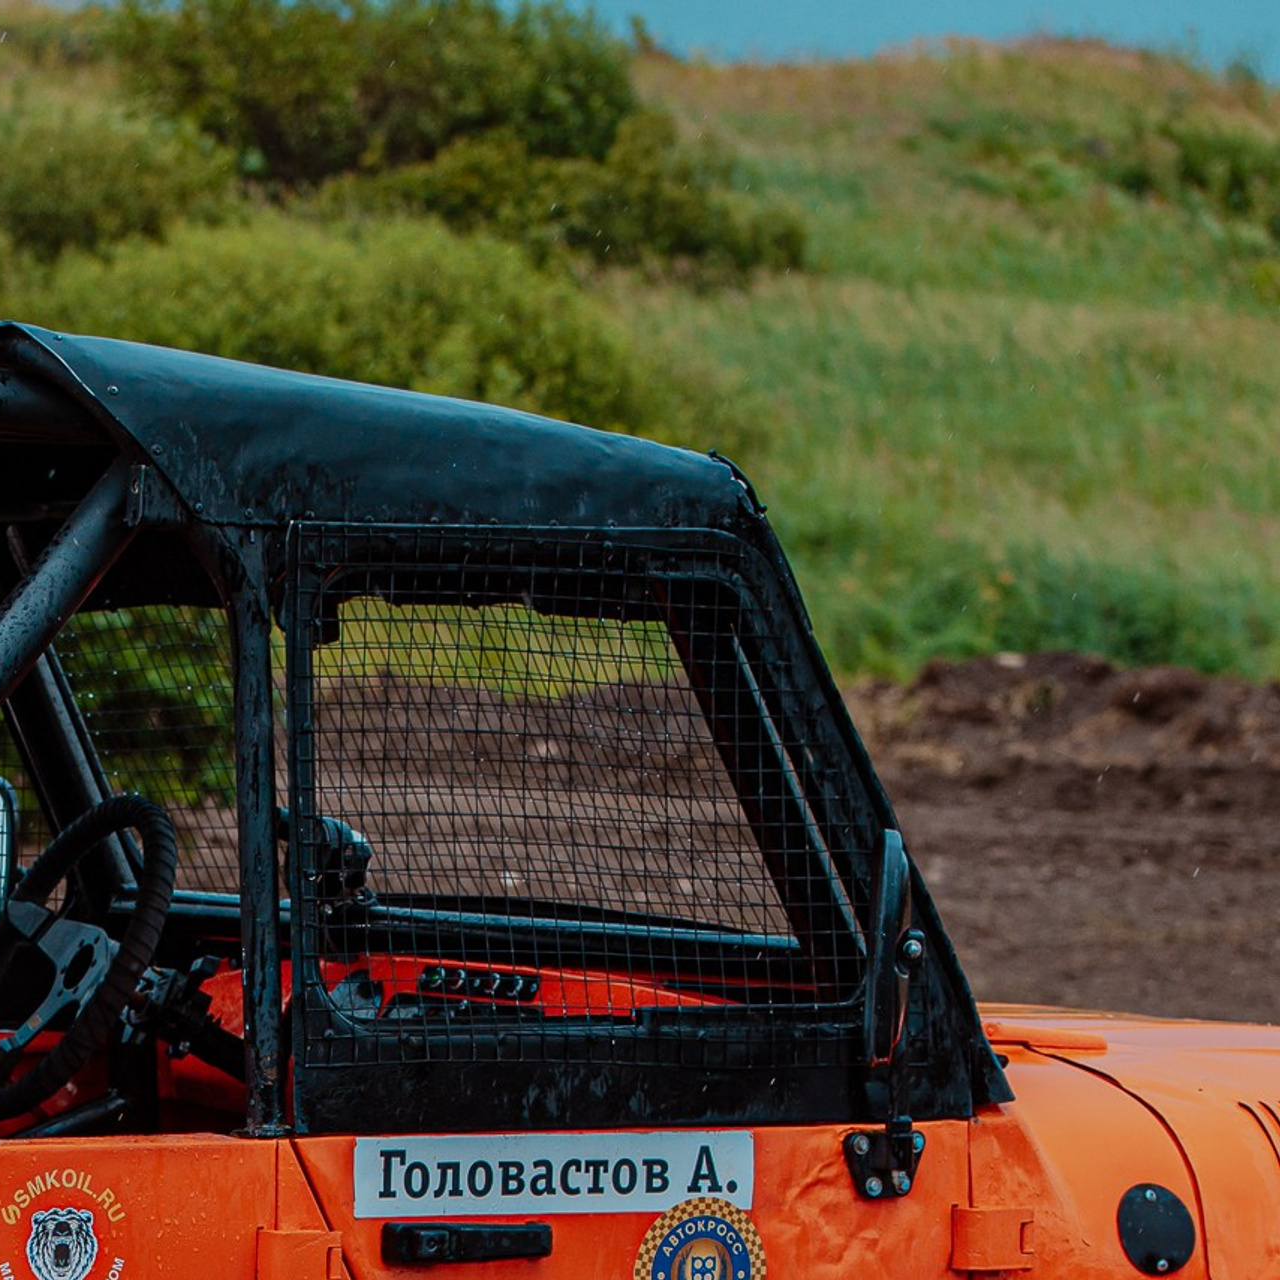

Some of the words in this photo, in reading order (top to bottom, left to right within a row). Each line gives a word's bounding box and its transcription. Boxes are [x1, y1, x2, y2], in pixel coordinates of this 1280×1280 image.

[378, 1148, 670, 1199] Головастов
[686, 1145, 739, 1194] А.
[662, 1219, 743, 1257] АВТОКРОСС
